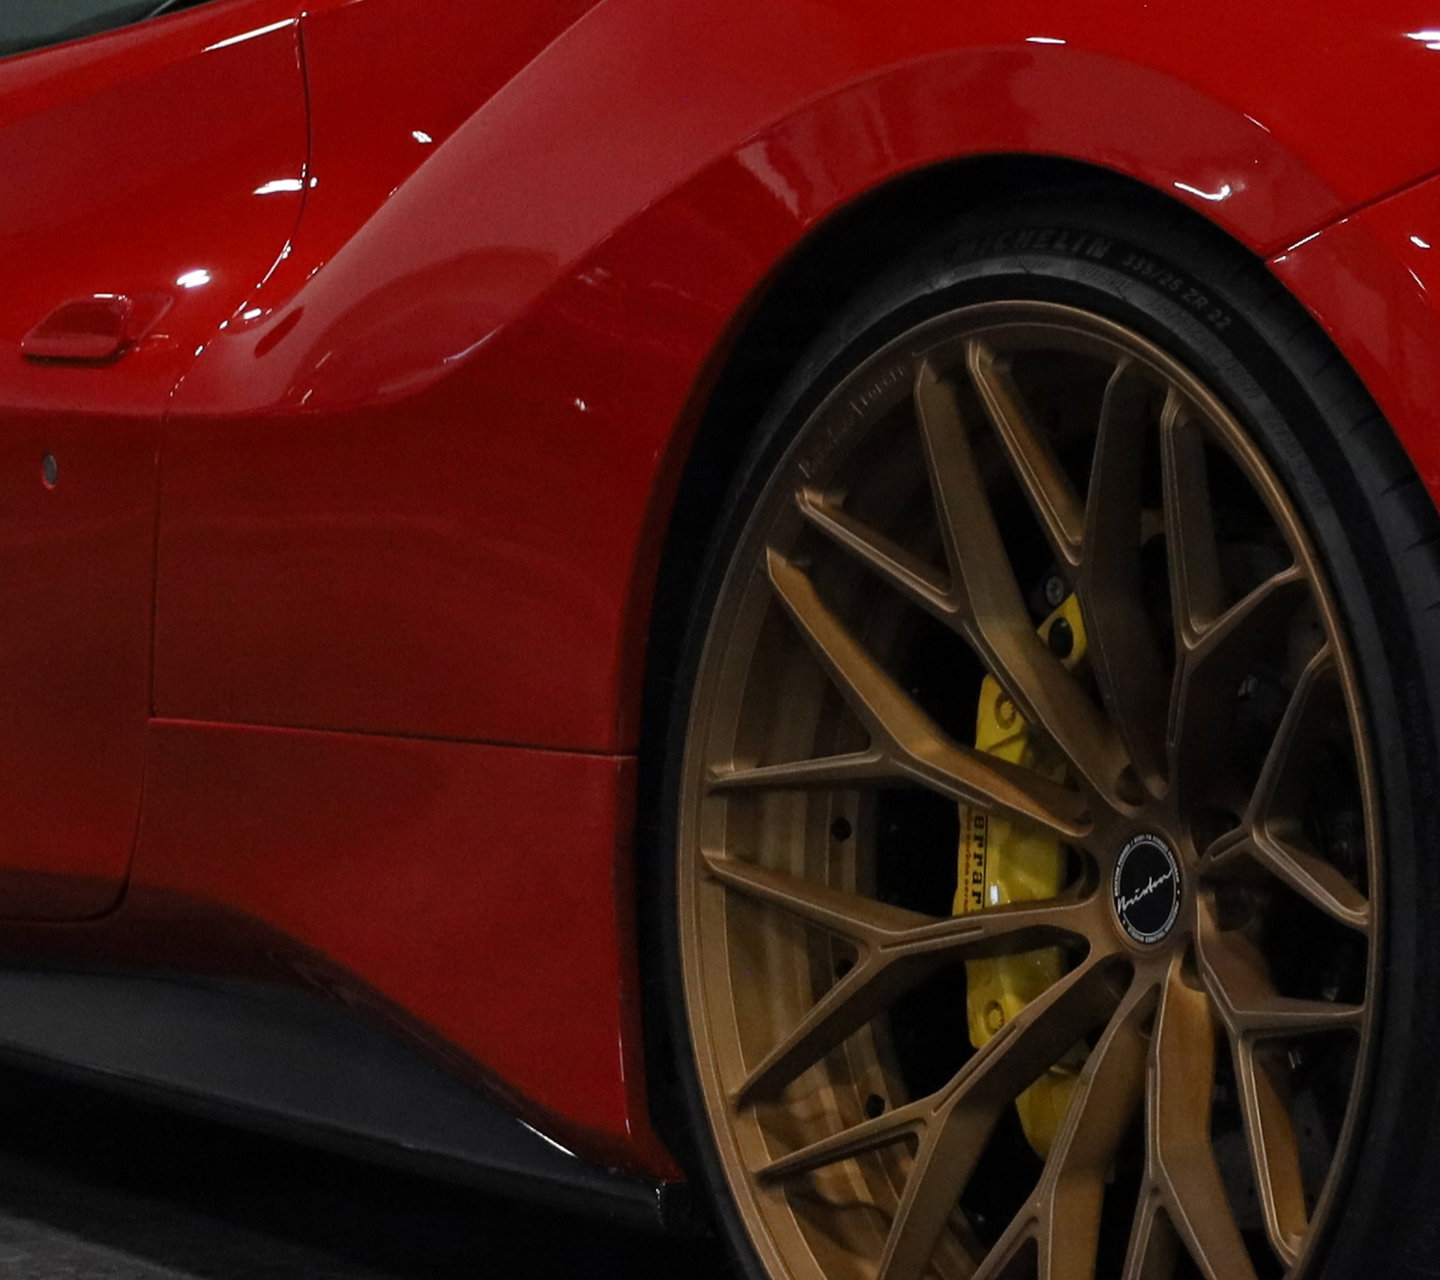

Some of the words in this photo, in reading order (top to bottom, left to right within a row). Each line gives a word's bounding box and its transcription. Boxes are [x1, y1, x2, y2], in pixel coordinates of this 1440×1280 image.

[1180, 287, 1209, 311] ZR
[1206, 308, 1233, 330] 22
[971, 814, 985, 910] errar
